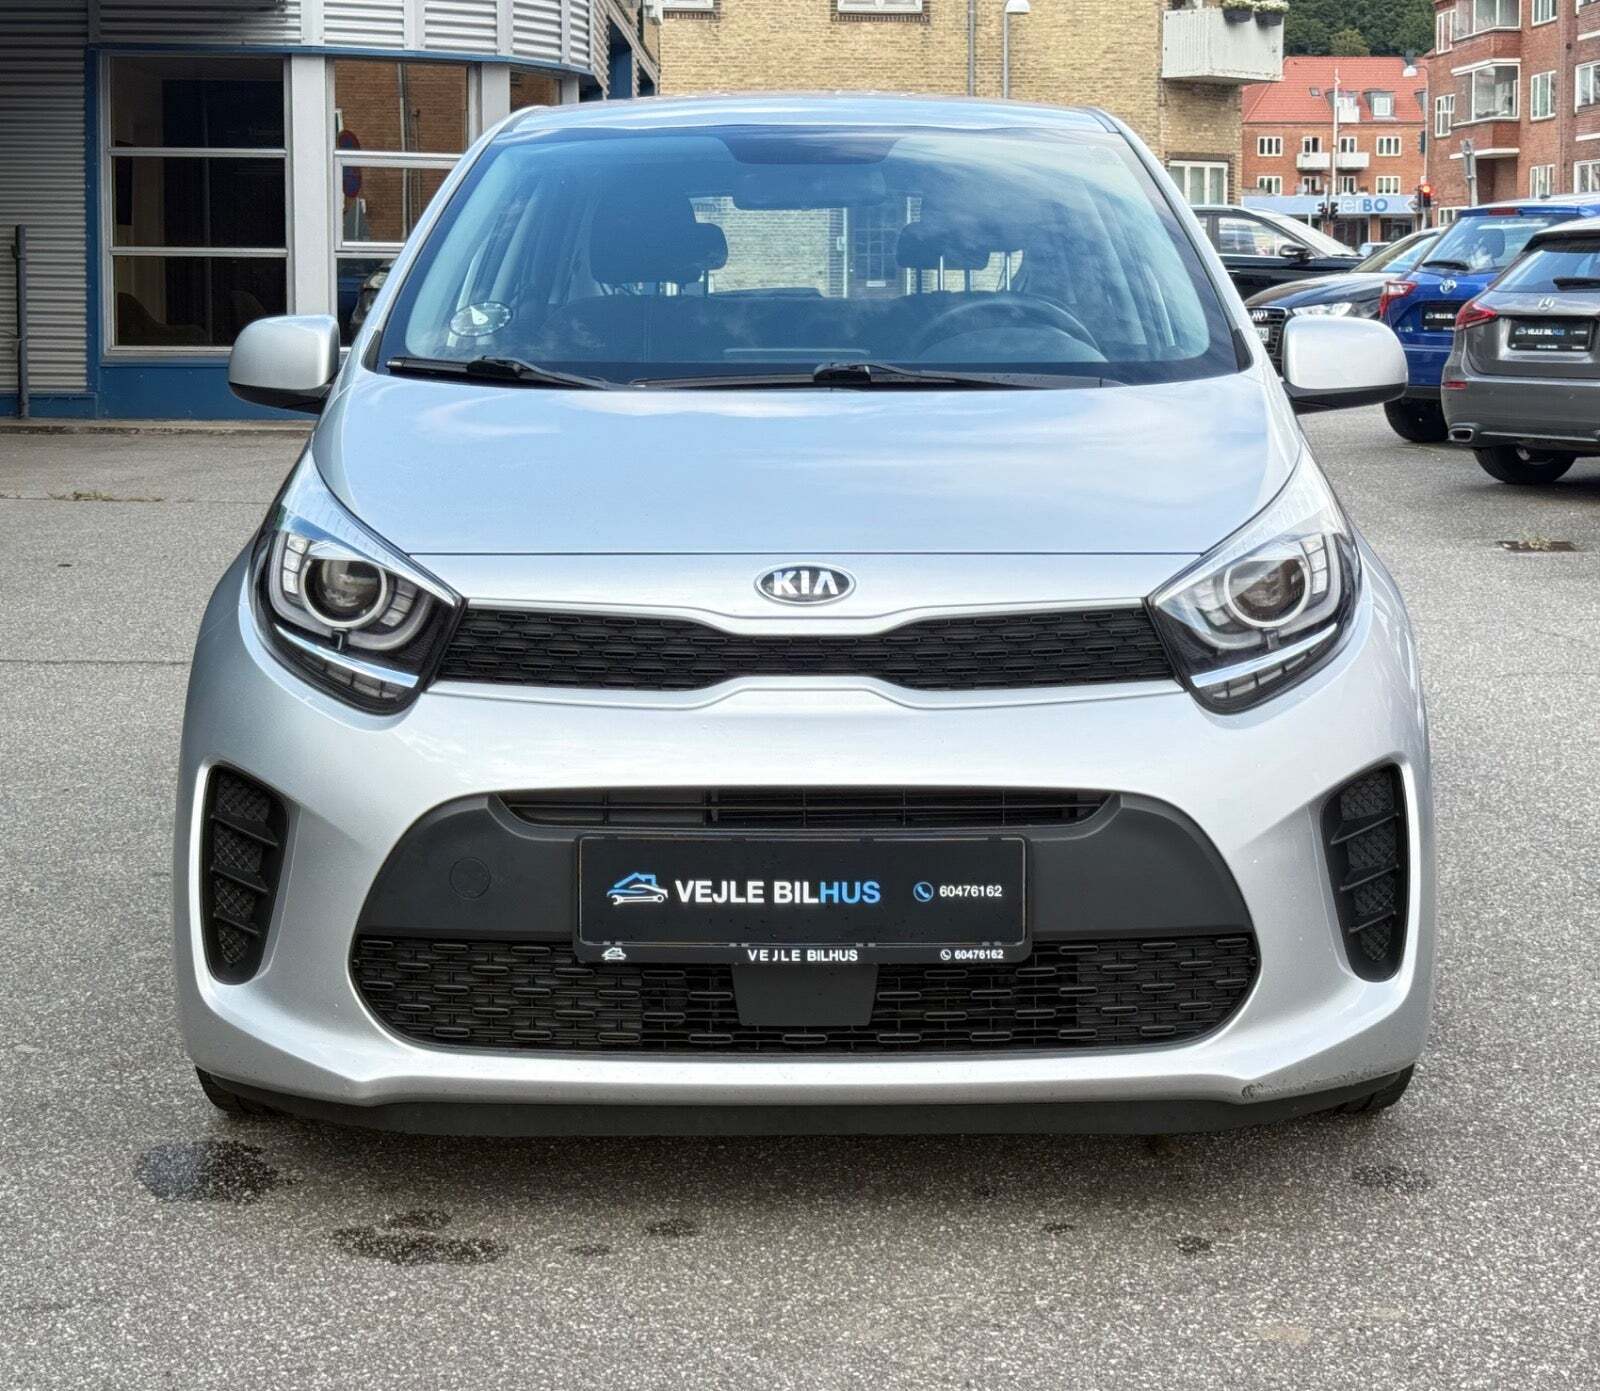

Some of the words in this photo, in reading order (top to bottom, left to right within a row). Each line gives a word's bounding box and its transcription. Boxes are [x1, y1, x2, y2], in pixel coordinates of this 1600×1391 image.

[773, 570, 839, 596] KIA
[675, 880, 765, 904] VEJLE
[773, 881, 881, 904] BILHUS
[939, 885, 1003, 898] 60476162
[747, 949, 801, 962] VEJLE
[806, 949, 858, 962] BILHUS
[954, 948, 1004, 960] 60476162
